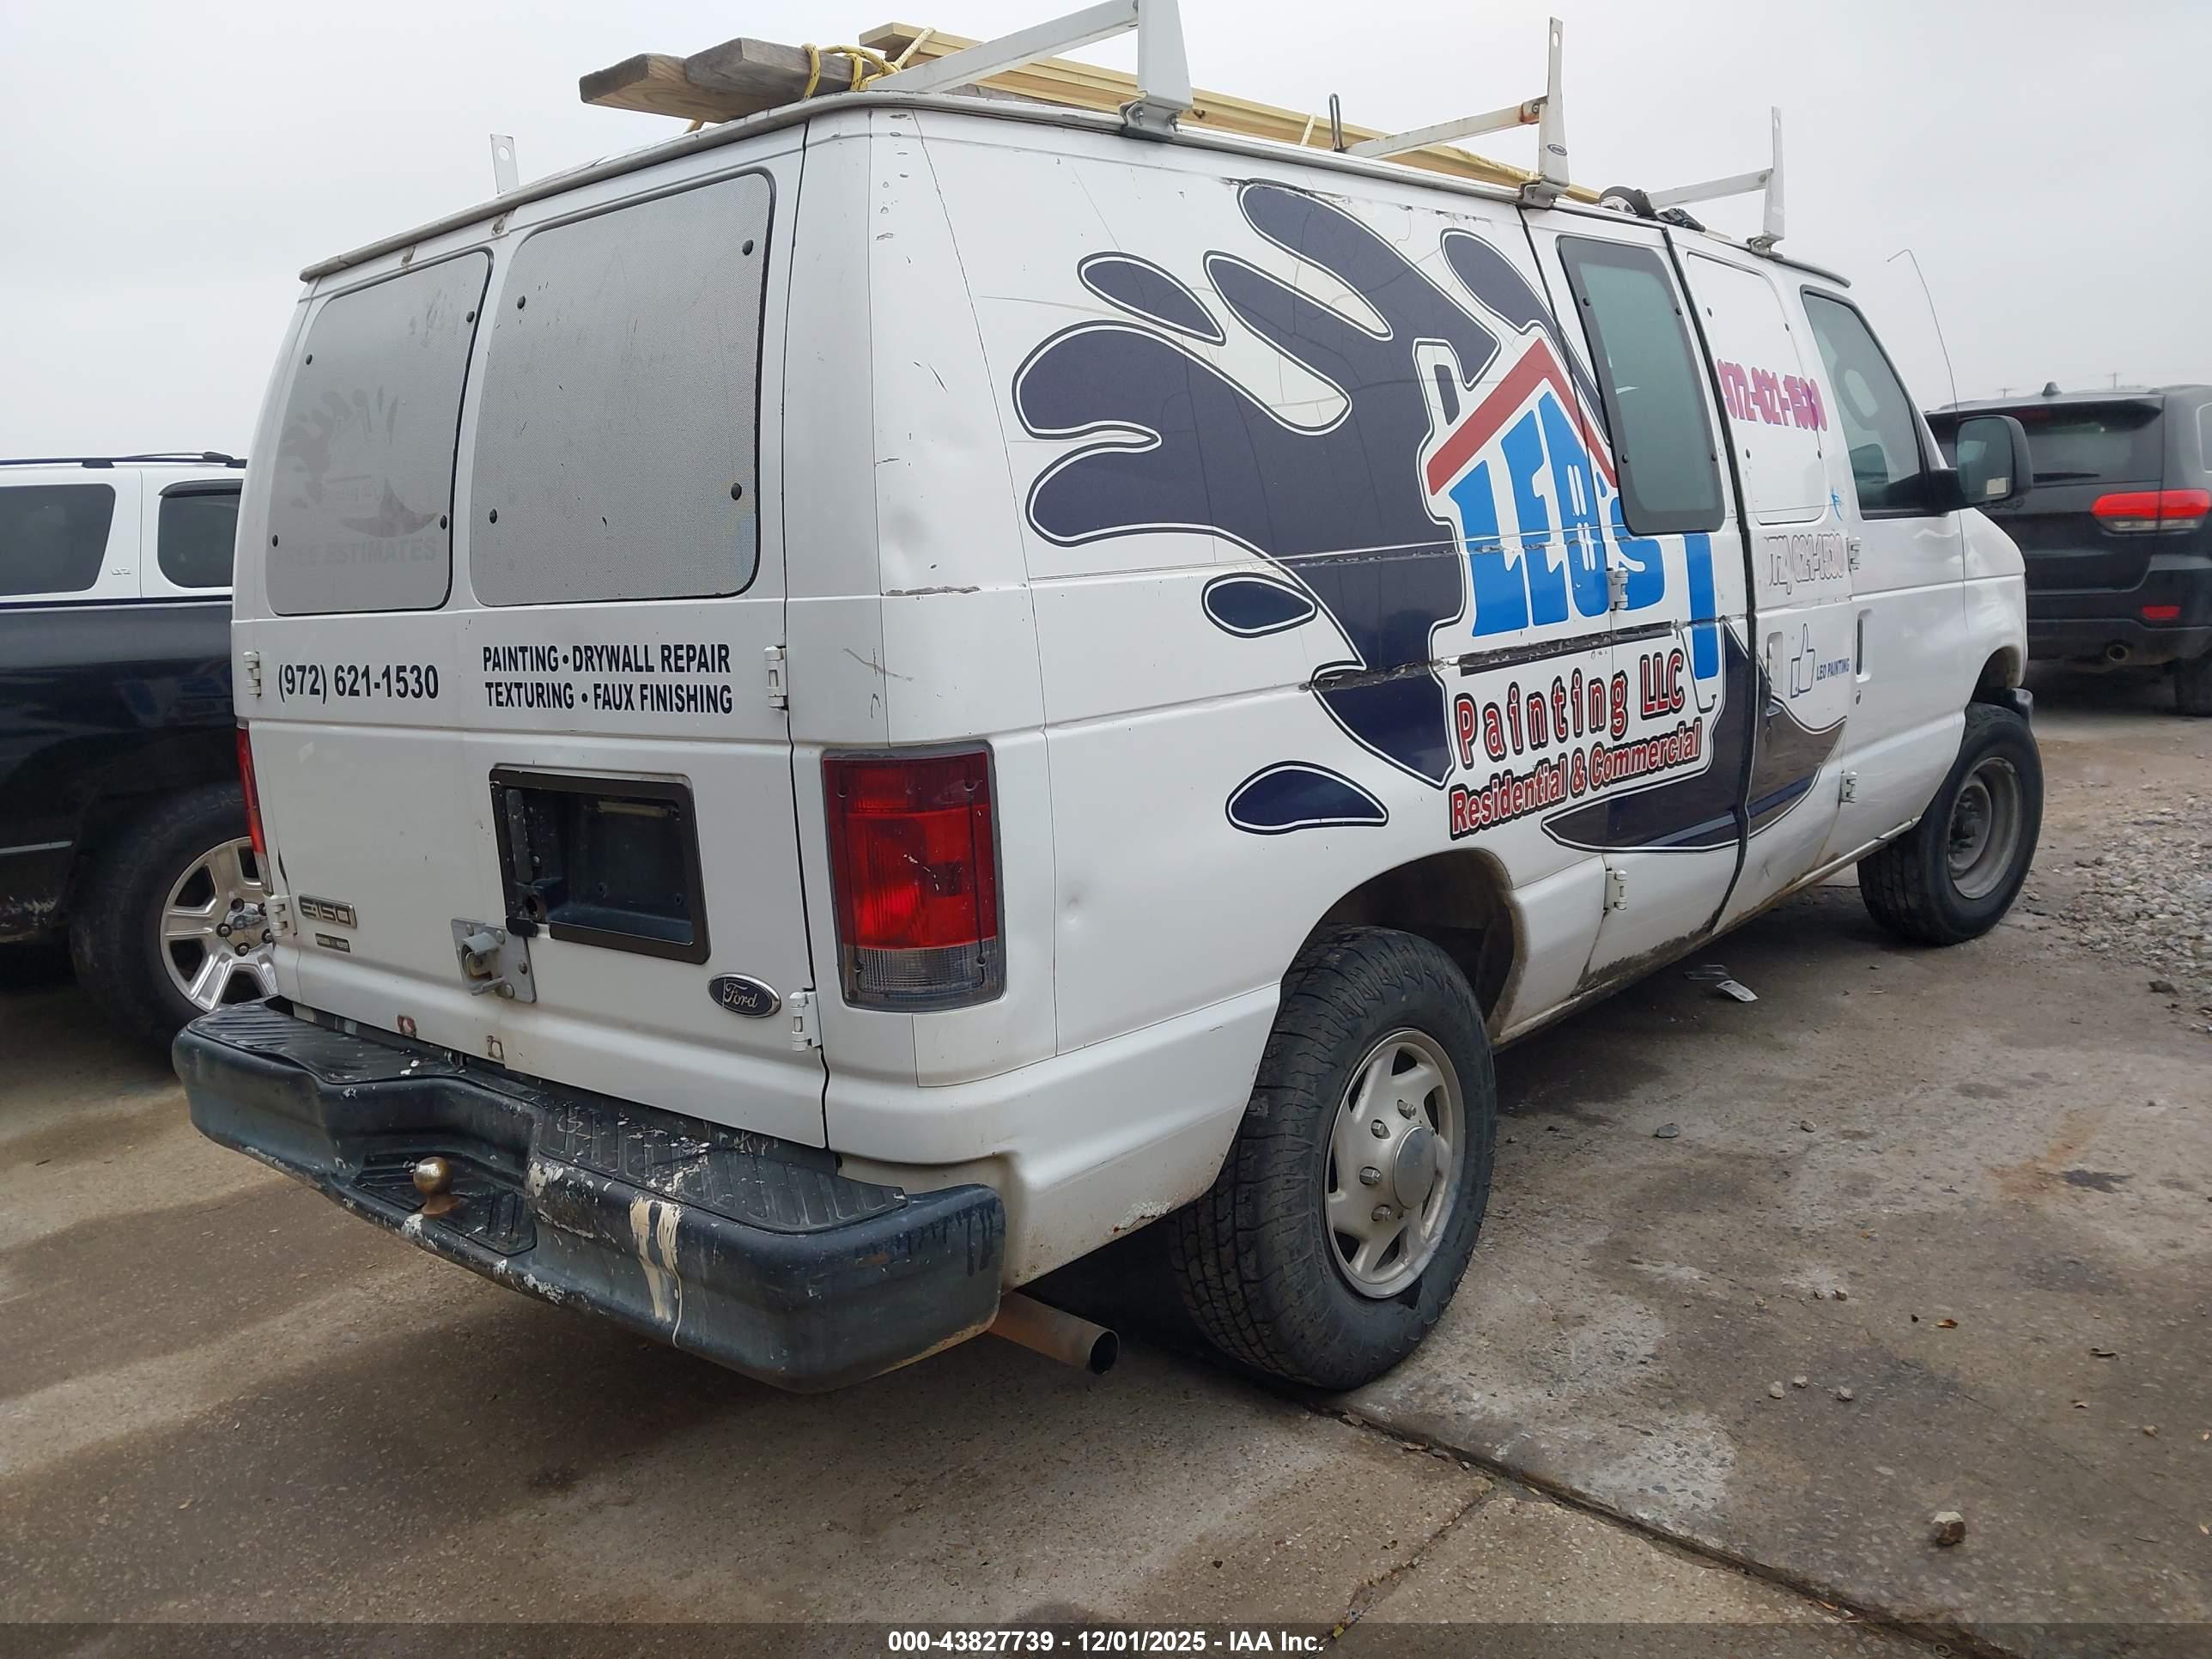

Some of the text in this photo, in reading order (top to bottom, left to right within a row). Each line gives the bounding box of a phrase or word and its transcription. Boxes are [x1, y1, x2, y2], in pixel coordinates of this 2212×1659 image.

[483, 644, 732, 673] PAINTING DRYWALL REPAIR
[1816, 663, 1827, 681] LEO
[278, 664, 439, 704] (972) 621-1530
[484, 682, 733, 714] TEXTURING FAUX FINISHING
[1452, 647, 1686, 770] Painting LLC
[1449, 719, 1702, 841] Residential & Commercial
[723, 982, 758, 1008] Ford
